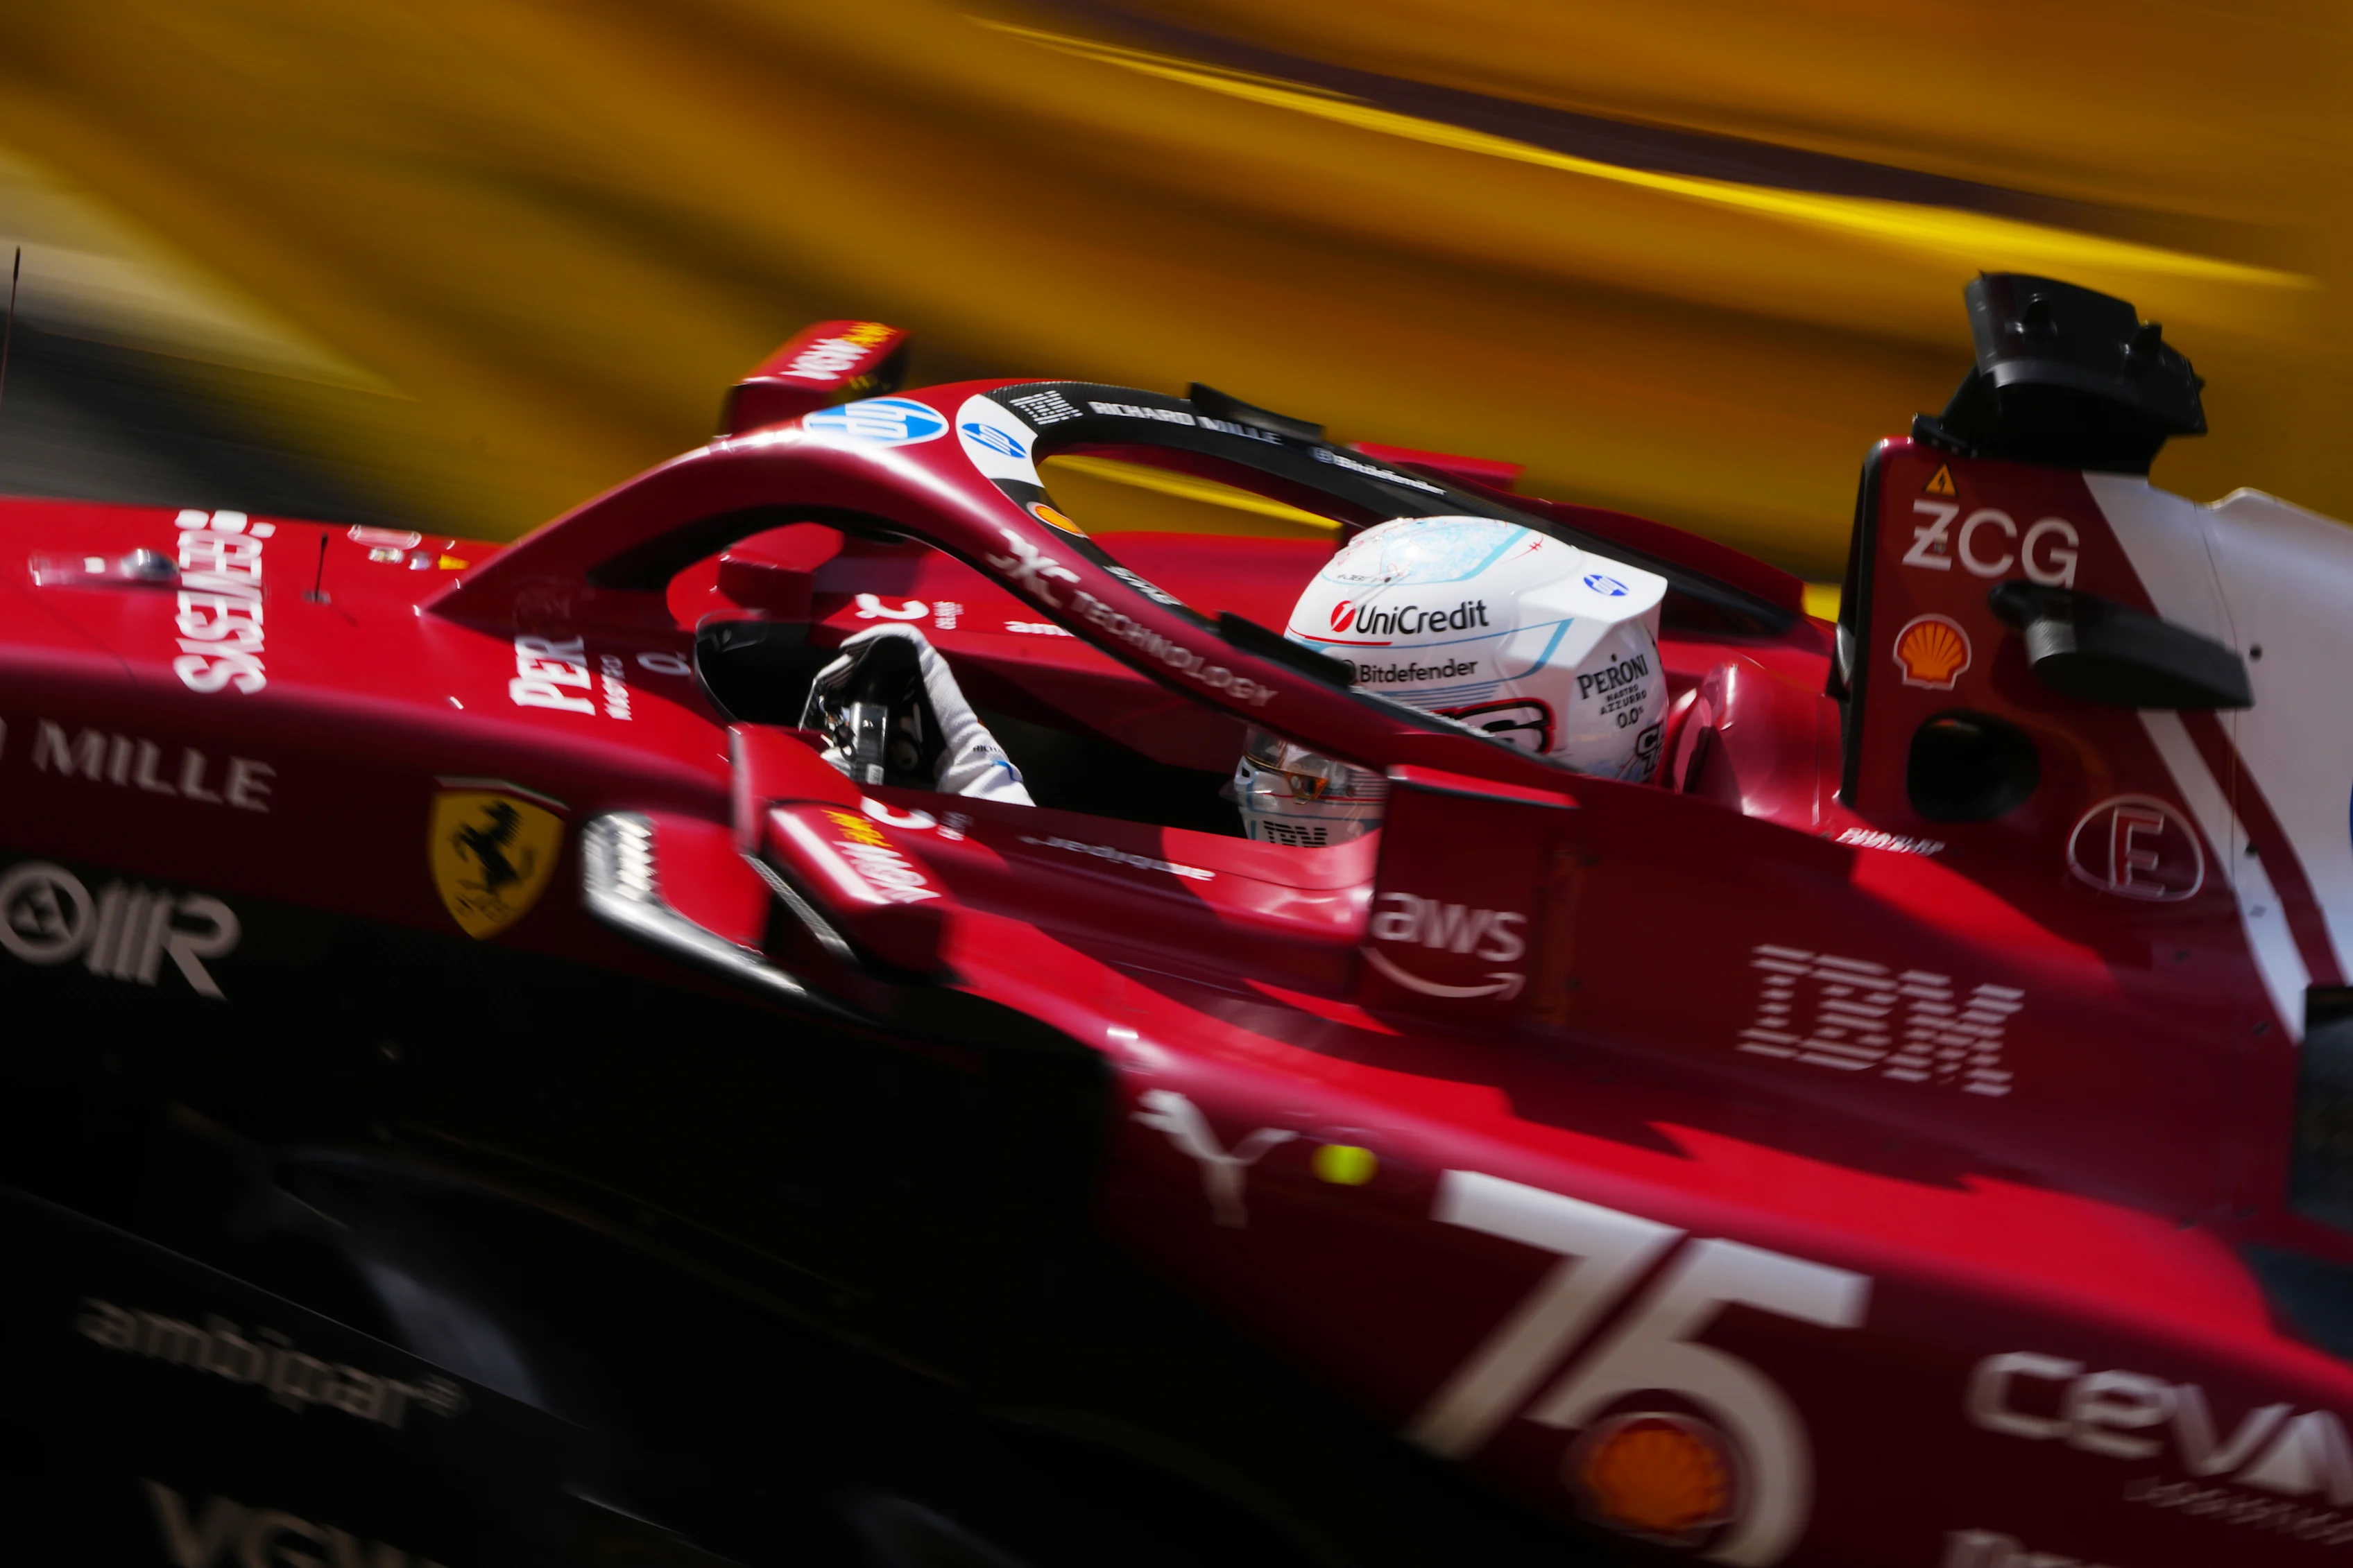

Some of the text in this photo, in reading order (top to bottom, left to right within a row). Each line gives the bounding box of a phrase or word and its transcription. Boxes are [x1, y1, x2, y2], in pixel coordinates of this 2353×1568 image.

[961, 422, 1028, 459] hp
[1087, 400, 1283, 446] RICHARD MILLE
[1332, 454, 1447, 496] Bitdefender
[1902, 499, 2080, 589] ZCG
[1355, 599, 1490, 635] UniCredit
[1068, 589, 1280, 707] TECHNOLOGY
[1359, 658, 1479, 684] Bitdefender
[1576, 654, 1649, 700] PERONI
[1606, 684, 1639, 703] NASTRO
[1600, 689, 1648, 716] AZZURRO
[32, 717, 279, 814] MILLE
[1369, 892, 1528, 962] aws
[1736, 942, 2026, 1097] IBM
[72, 1295, 409, 1430] ambipar
